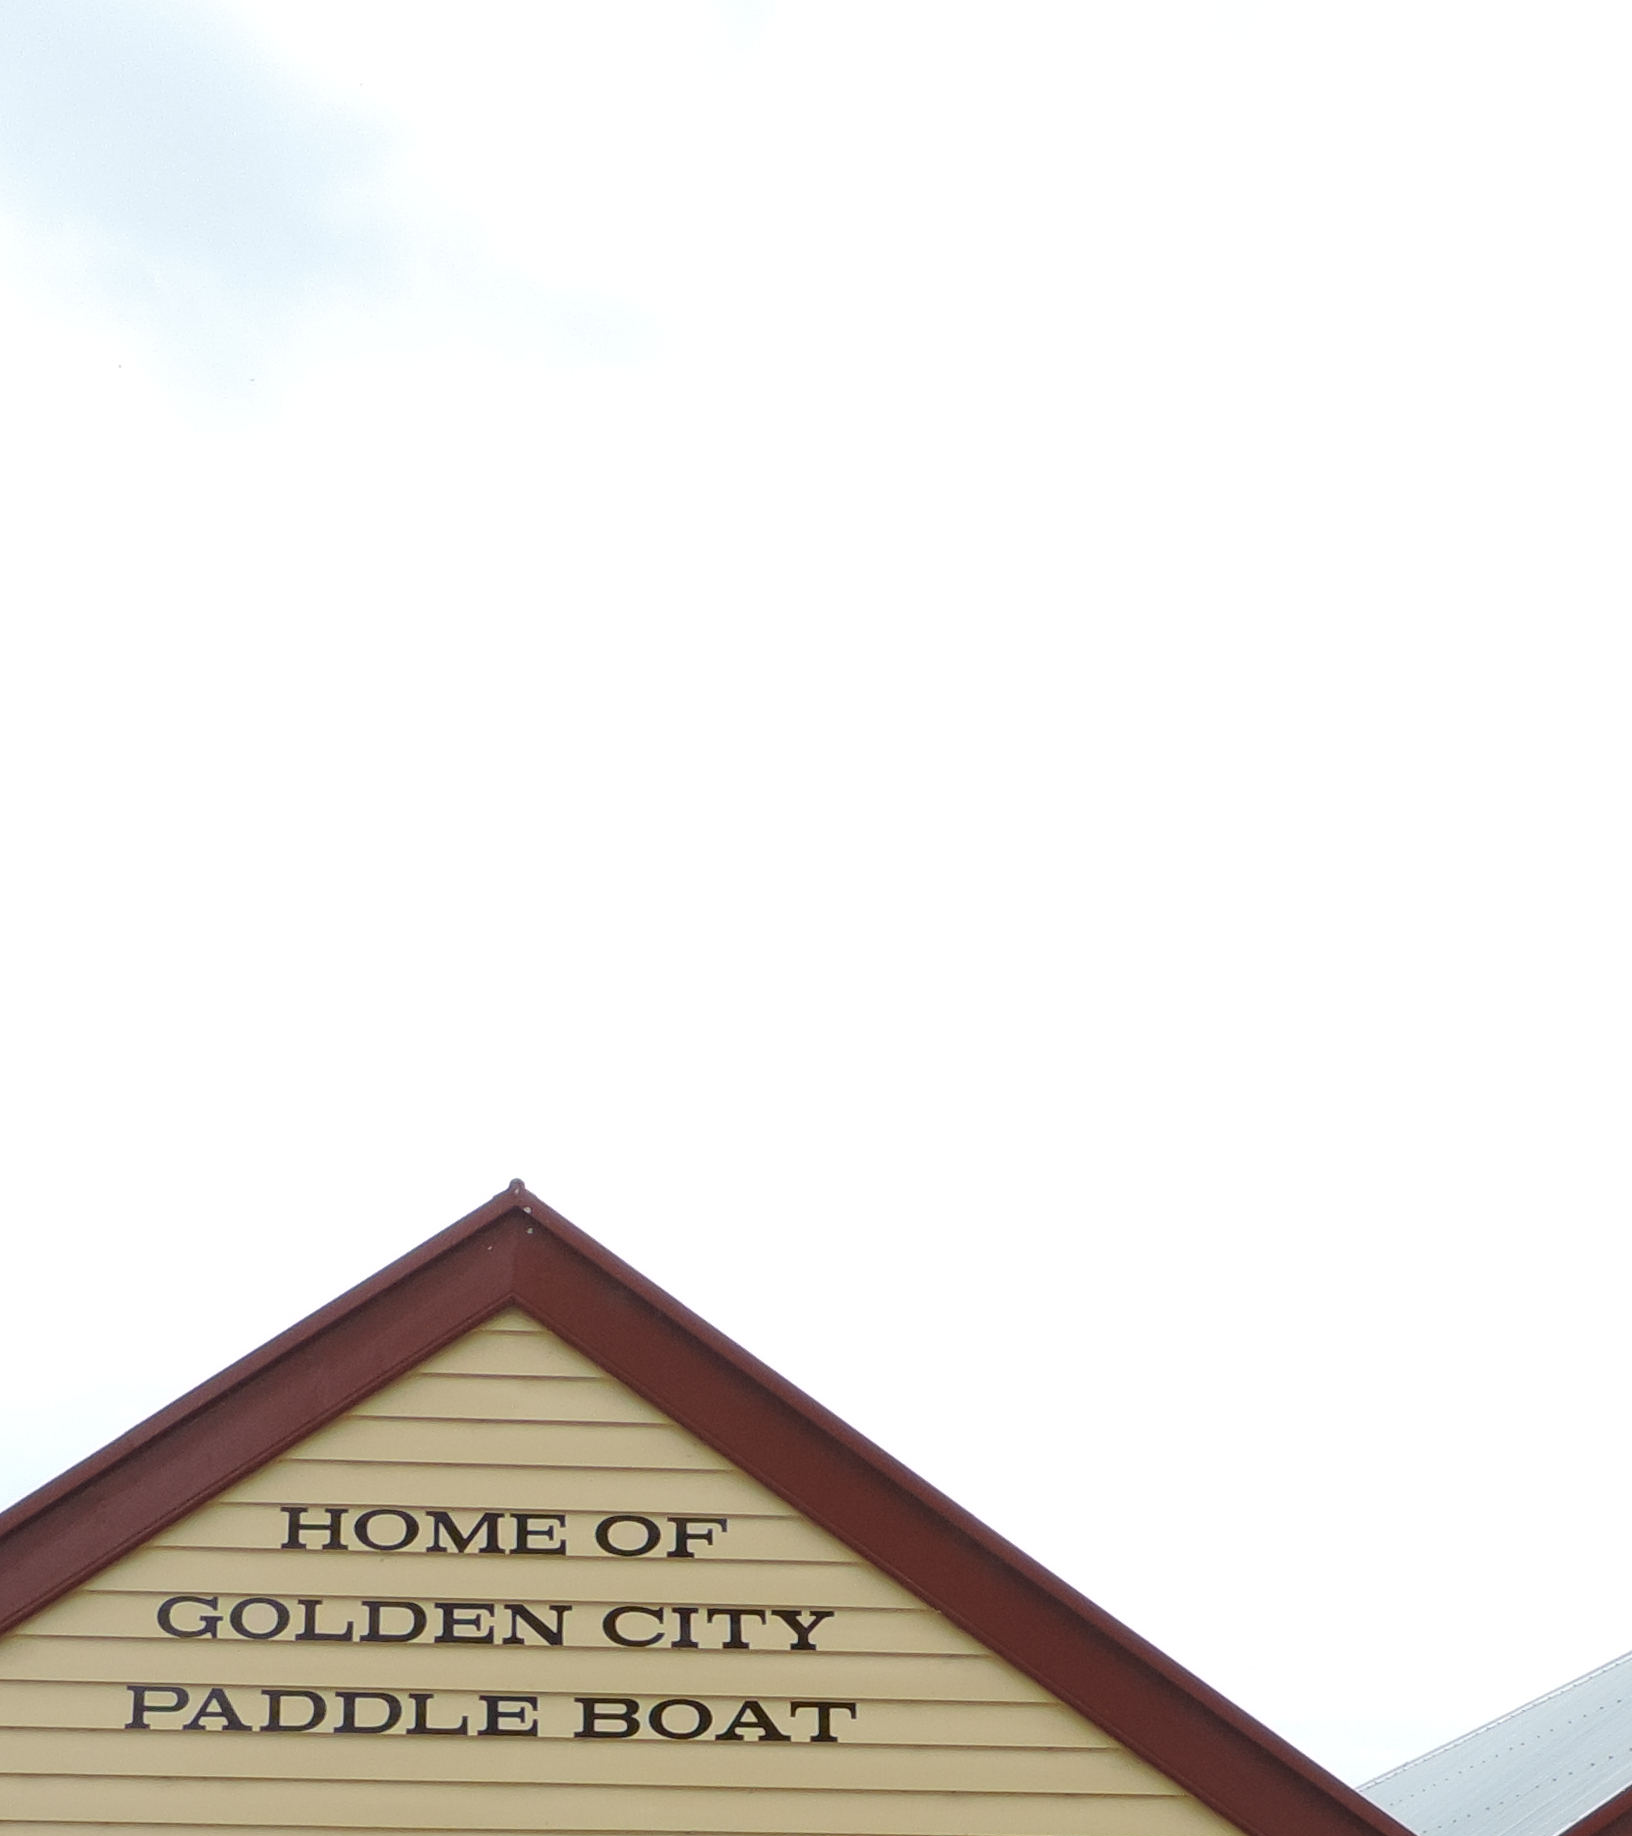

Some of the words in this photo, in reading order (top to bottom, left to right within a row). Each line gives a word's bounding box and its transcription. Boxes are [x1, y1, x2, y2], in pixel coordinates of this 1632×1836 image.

[279, 1506, 567, 1557] HOME
[595, 1514, 729, 1559] OF
[156, 1595, 573, 1647] GOLDEN
[602, 1605, 836, 1651] CITY
[124, 1684, 540, 1738] PADDLE
[573, 1696, 858, 1743] BOAT
